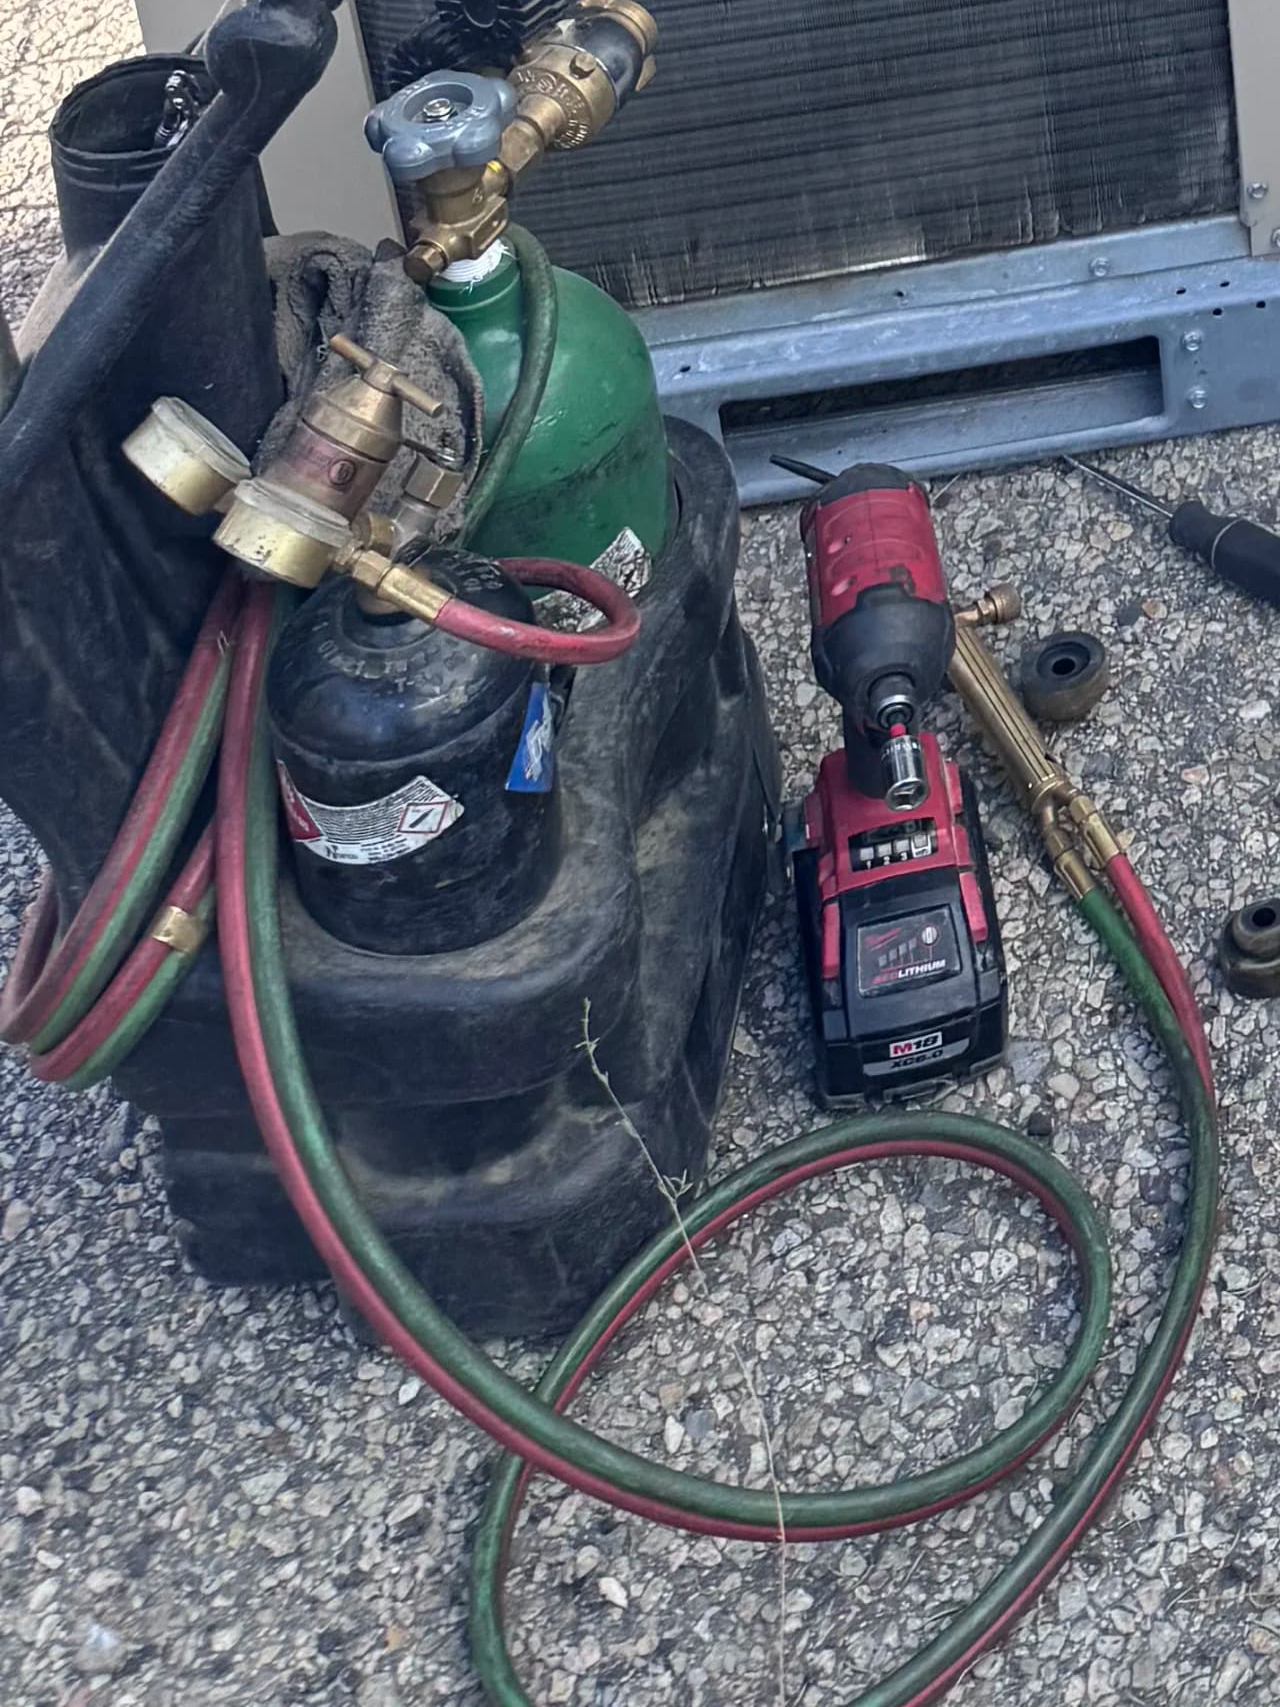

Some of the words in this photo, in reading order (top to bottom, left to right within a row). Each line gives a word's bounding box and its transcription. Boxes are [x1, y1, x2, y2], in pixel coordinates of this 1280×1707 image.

[883, 857, 891, 866] 2
[900, 852, 908, 861] 3
[893, 1035, 939, 1055] M18
